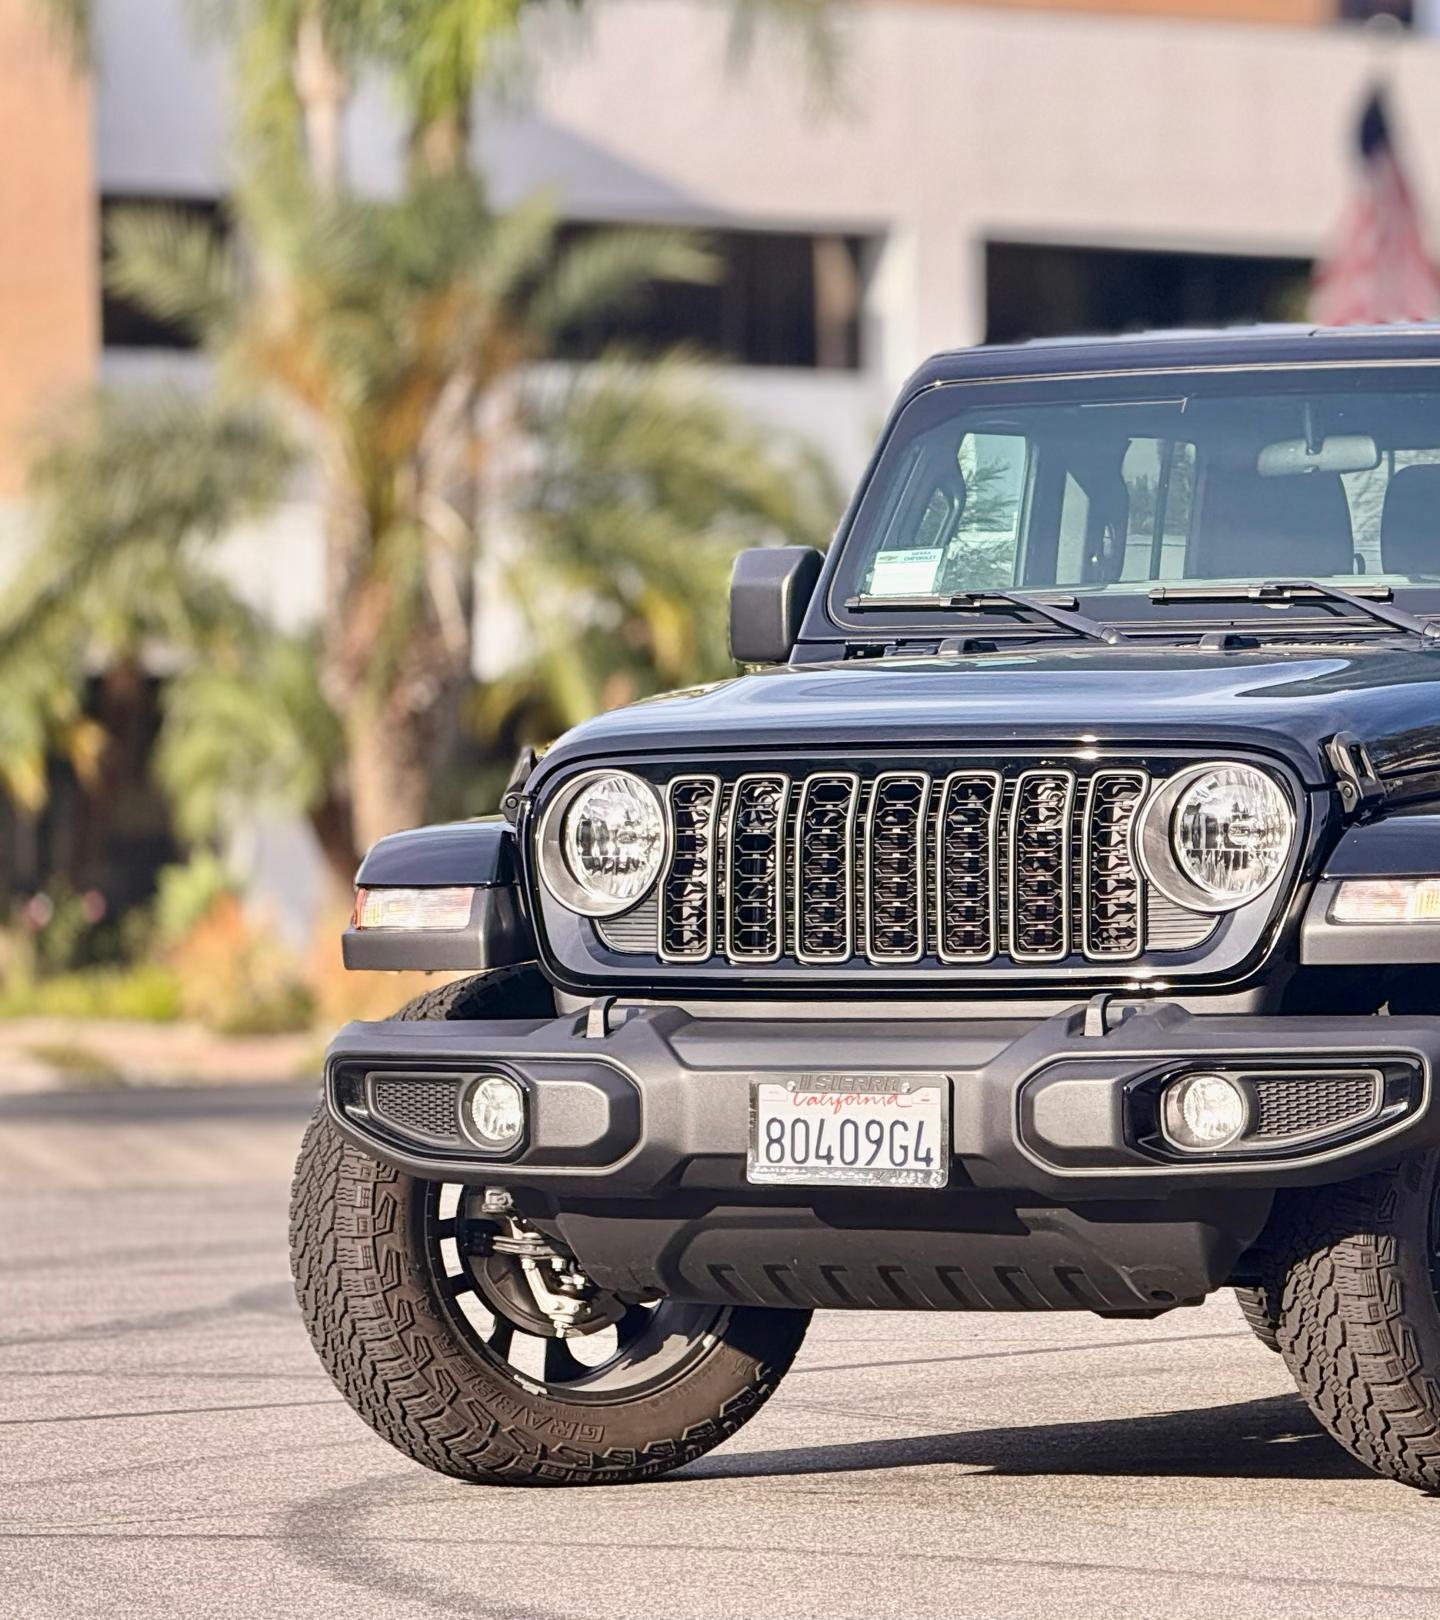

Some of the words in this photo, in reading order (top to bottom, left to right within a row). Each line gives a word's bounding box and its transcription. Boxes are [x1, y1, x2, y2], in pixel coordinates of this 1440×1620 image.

[815, 1074, 898, 1092] SIERRA
[791, 1091, 913, 1115] California
[765, 1117, 934, 1168] 80409G4
[432, 1334, 605, 1444] GRABBER
